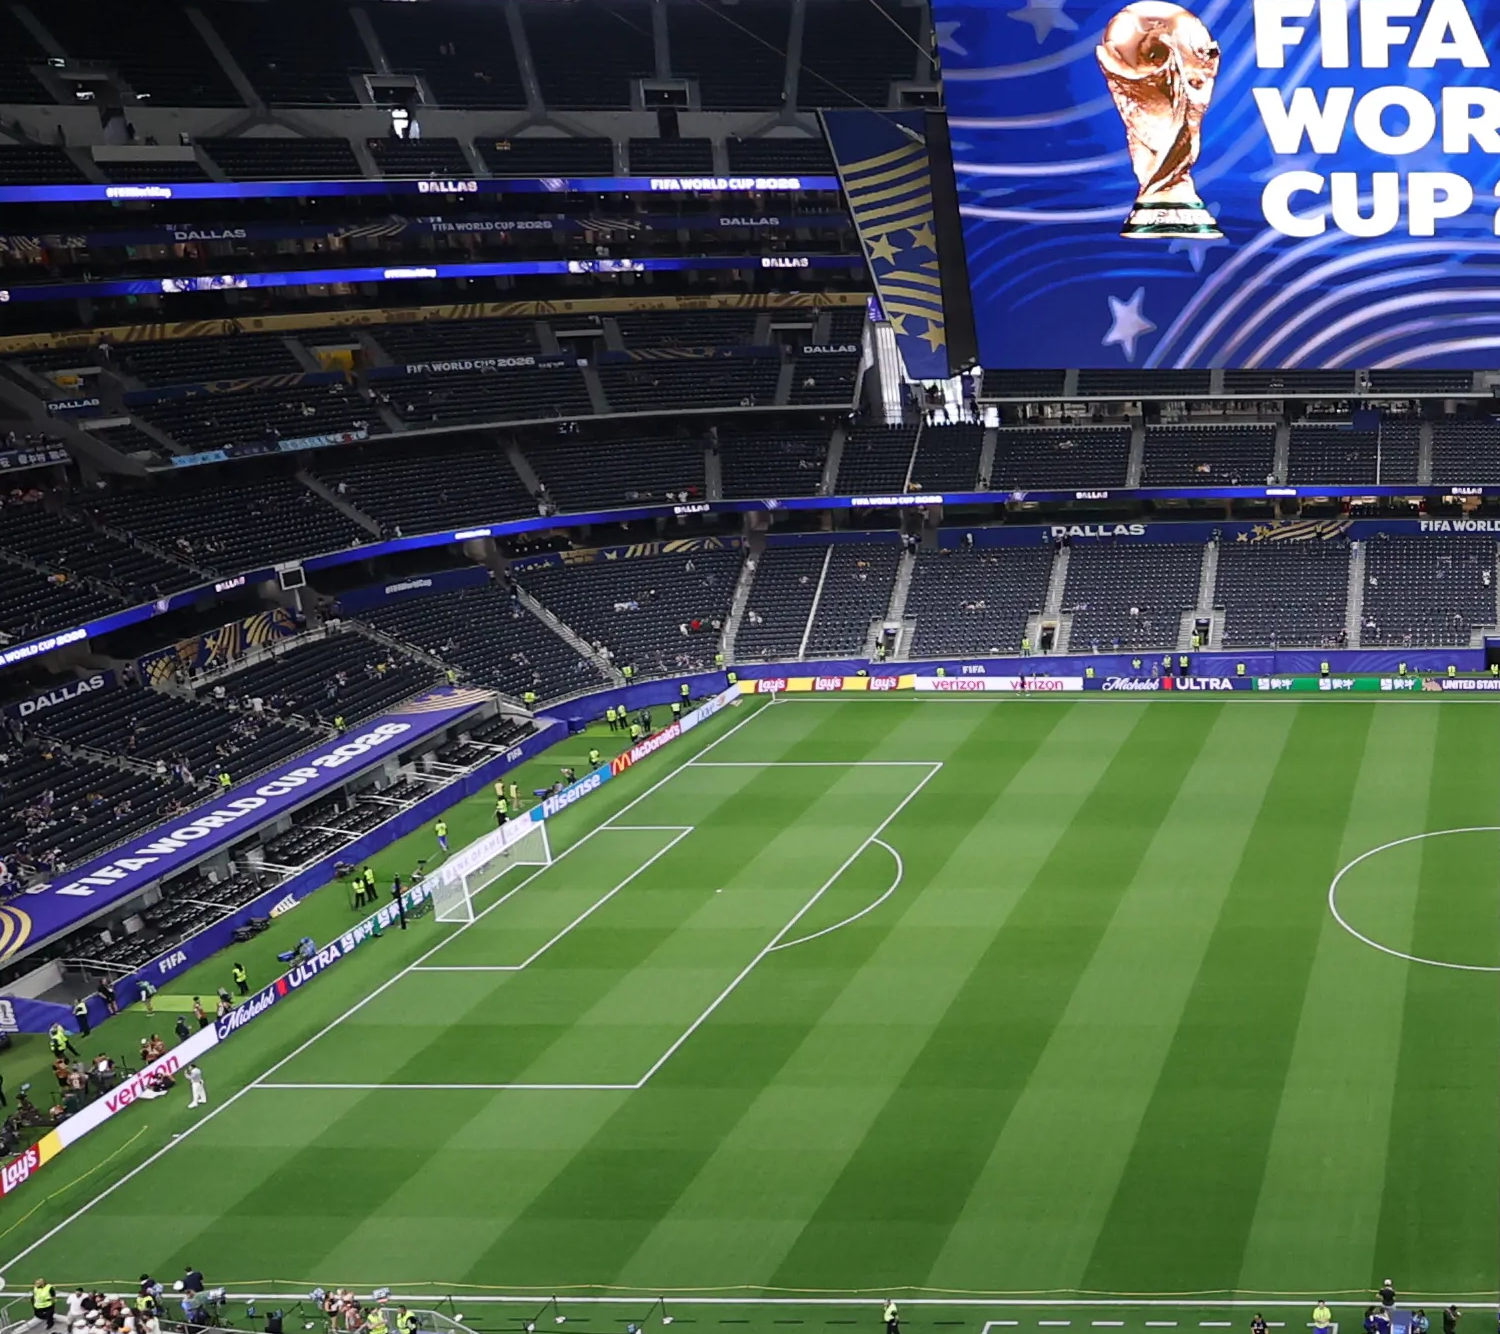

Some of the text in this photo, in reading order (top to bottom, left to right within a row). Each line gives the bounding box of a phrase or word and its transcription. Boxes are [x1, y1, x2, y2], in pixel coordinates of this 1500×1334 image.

[418, 181, 478, 193] DALLAS
[651, 178, 800, 190] FIFA WORLD CUP 2026
[1261, 170, 1474, 238] CUP
[174, 229, 247, 240] DALLAS
[761, 256, 809, 267] DALLAS
[1051, 524, 1145, 537] DALLAS
[1420, 521, 1451, 532] FIFA
[4, 645, 38, 663] WORLD
[38, 639, 56, 651] CUP
[56, 629, 87, 646] 2026
[962, 665, 985, 674] FIFA
[758, 678, 785, 692] Lay's
[815, 677, 842, 691] Lay's
[870, 677, 897, 691] Lay's
[932, 678, 985, 691] verizon
[1010, 678, 1064, 691] verizon
[1102, 677, 1233, 691] Michelob ULTRA
[1441, 680, 1476, 690] UNITED
[19, 674, 105, 716] DALLAS
[542, 774, 601, 818] Hisense
[55, 723, 411, 896] FIFA WORLD CUP 2026
[158, 950, 187, 974] FIFA
[219, 944, 341, 1037] Michelob ULTRA
[1, 1149, 37, 1194] Lay's
